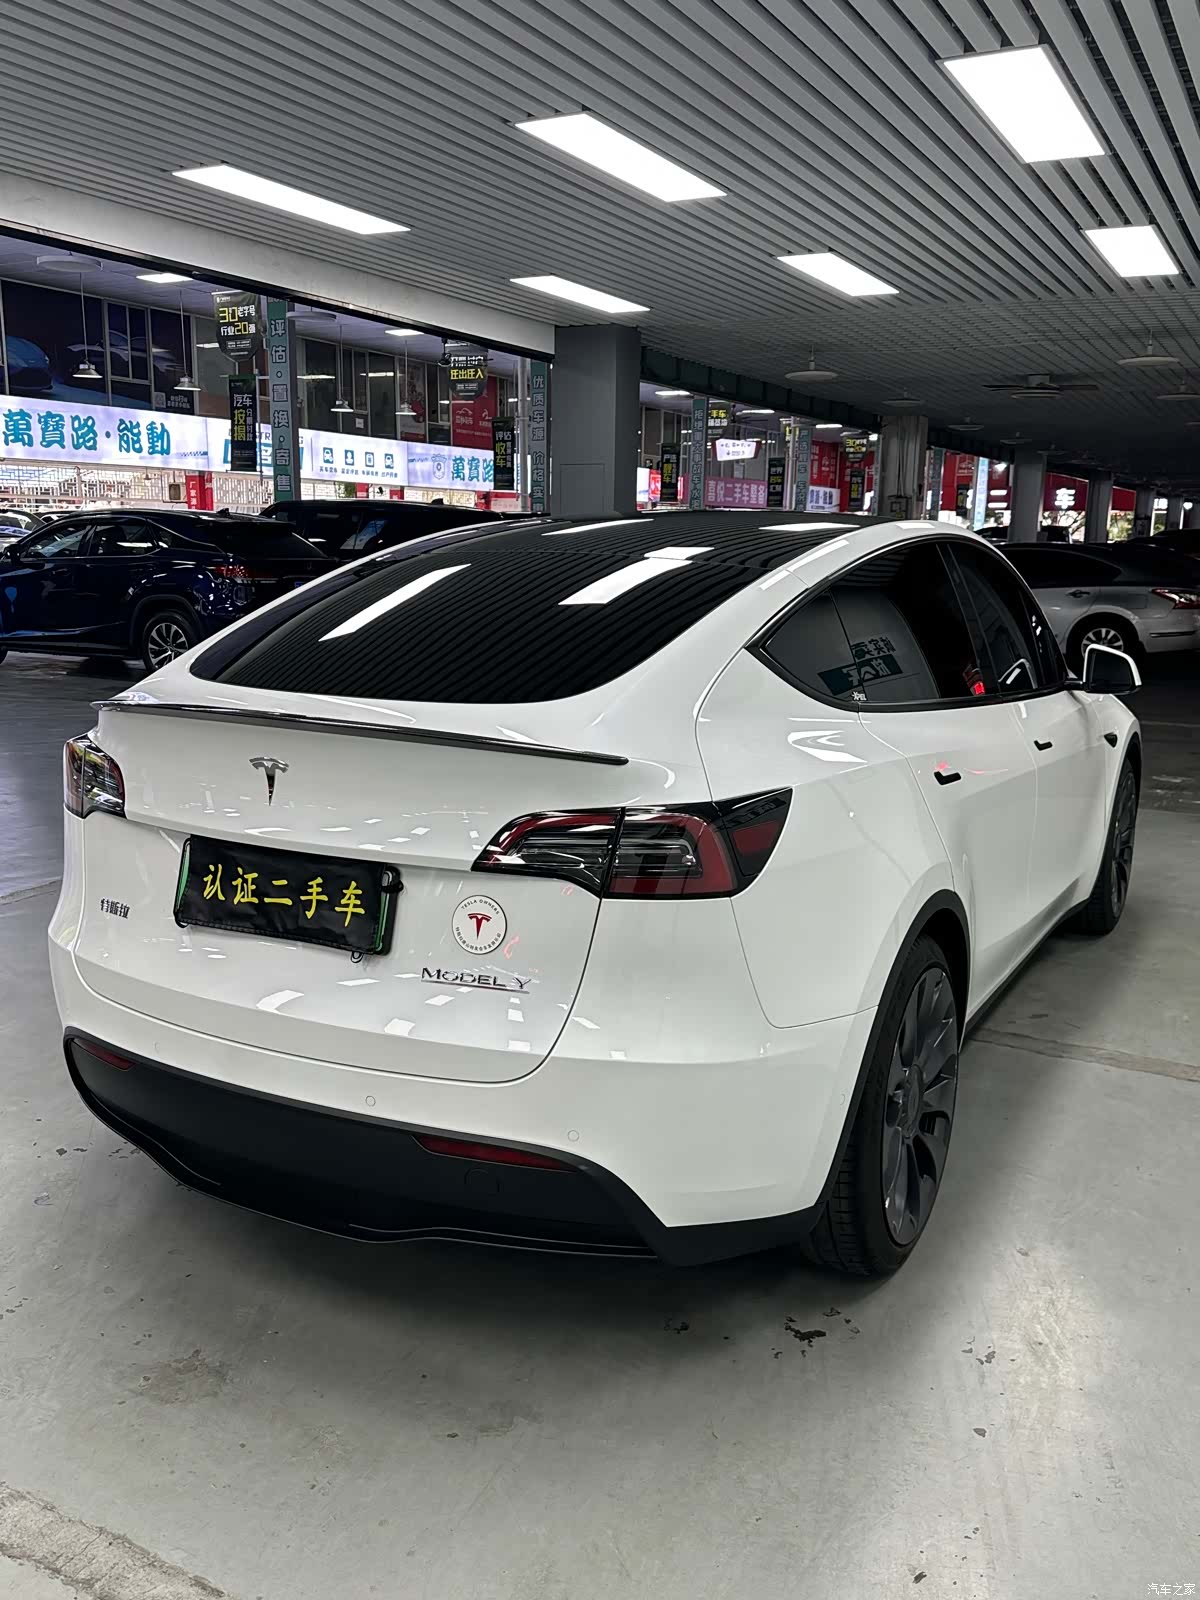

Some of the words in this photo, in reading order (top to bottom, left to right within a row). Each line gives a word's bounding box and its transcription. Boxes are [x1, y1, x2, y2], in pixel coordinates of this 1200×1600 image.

[234, 394, 253, 407] 汽车
[532, 375, 544, 441] 优质车源
[233, 408, 246, 441] 按揭
[496, 441, 506, 468] 收车
[1055, 487, 1076, 510] 车
[203, 864, 366, 928] 认证二手车
[461, 899, 478, 910] TESLA
[478, 899, 500, 915] OWNERS
[100, 898, 130, 920] 特斯拉
[421, 967, 507, 988] MODEL
[513, 976, 532, 990] Y
